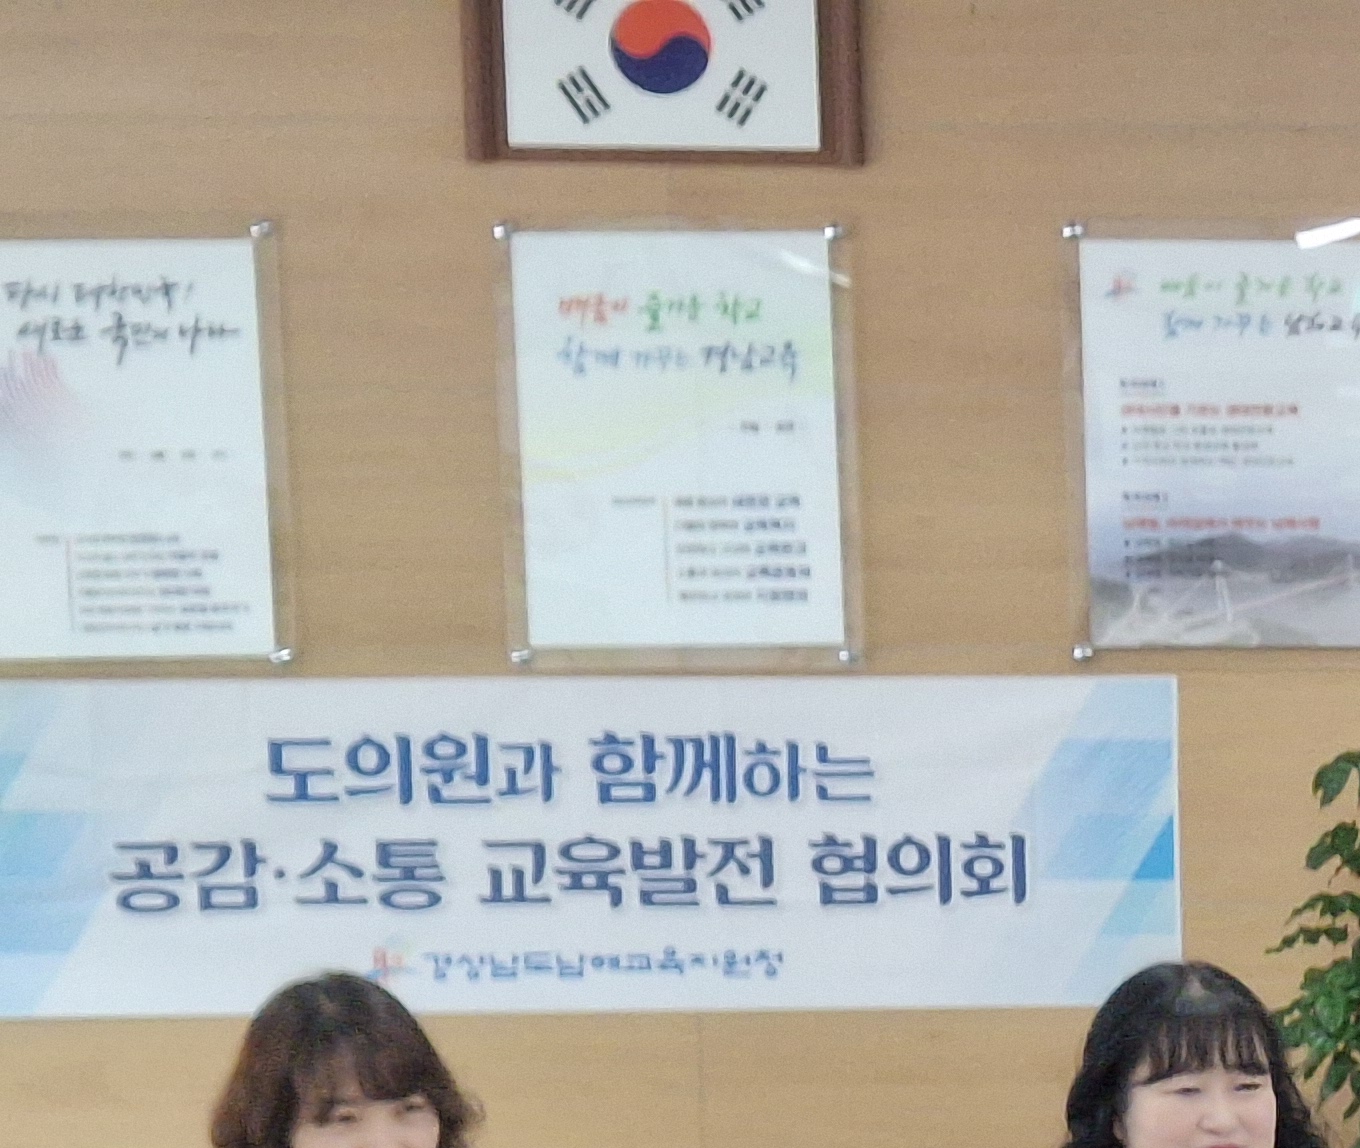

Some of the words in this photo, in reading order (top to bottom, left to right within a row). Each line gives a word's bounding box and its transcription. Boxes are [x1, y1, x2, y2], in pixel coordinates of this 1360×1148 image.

[266, 733, 561, 806] 도의원과
[589, 731, 876, 805] 함께하는
[111, 839, 447, 914] 공감·소통
[479, 835, 778, 910] 교육발전
[808, 832, 1028, 908] 협의회
